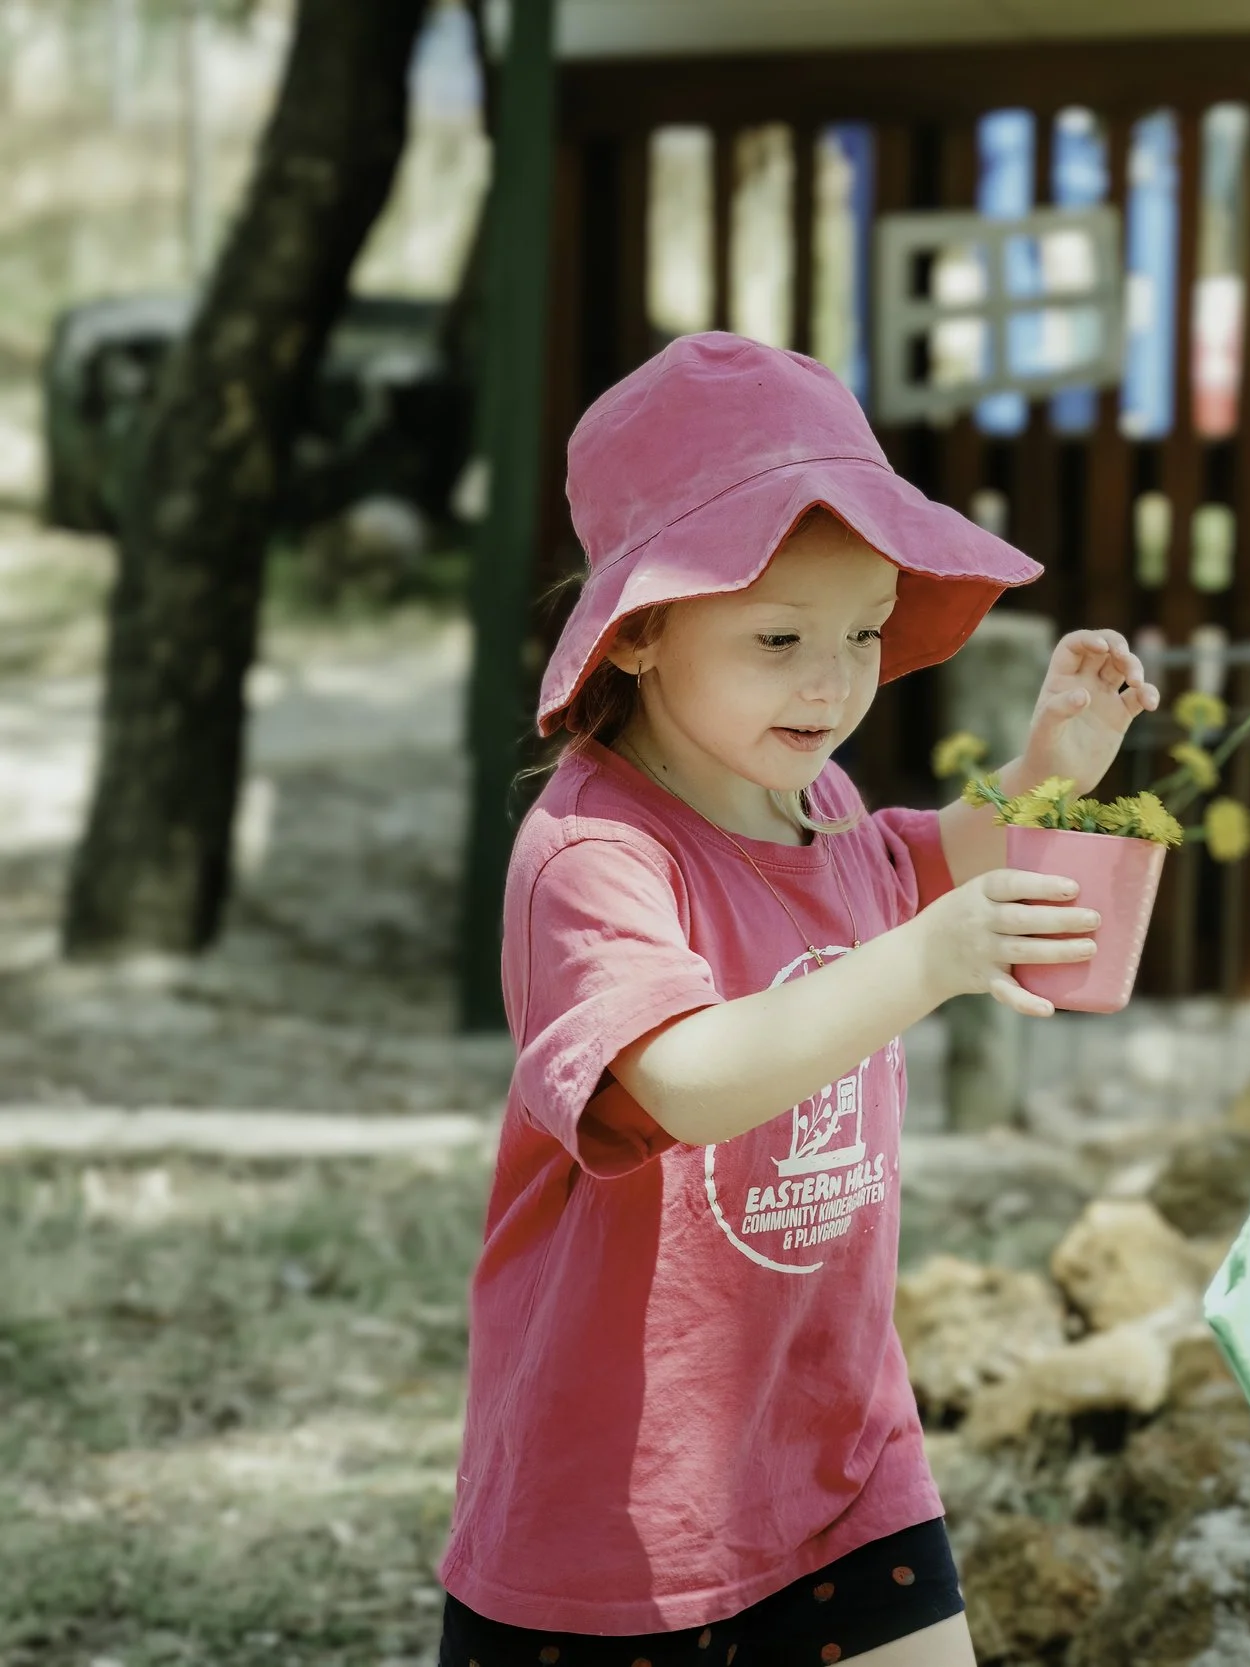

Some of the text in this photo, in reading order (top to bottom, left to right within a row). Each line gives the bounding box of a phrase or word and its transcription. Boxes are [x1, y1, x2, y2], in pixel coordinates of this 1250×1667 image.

[745, 1173, 842, 1213] EASTERN
[741, 1204, 818, 1234] COMMUNITY
[783, 1216, 852, 1250] & PLAYGROUP
